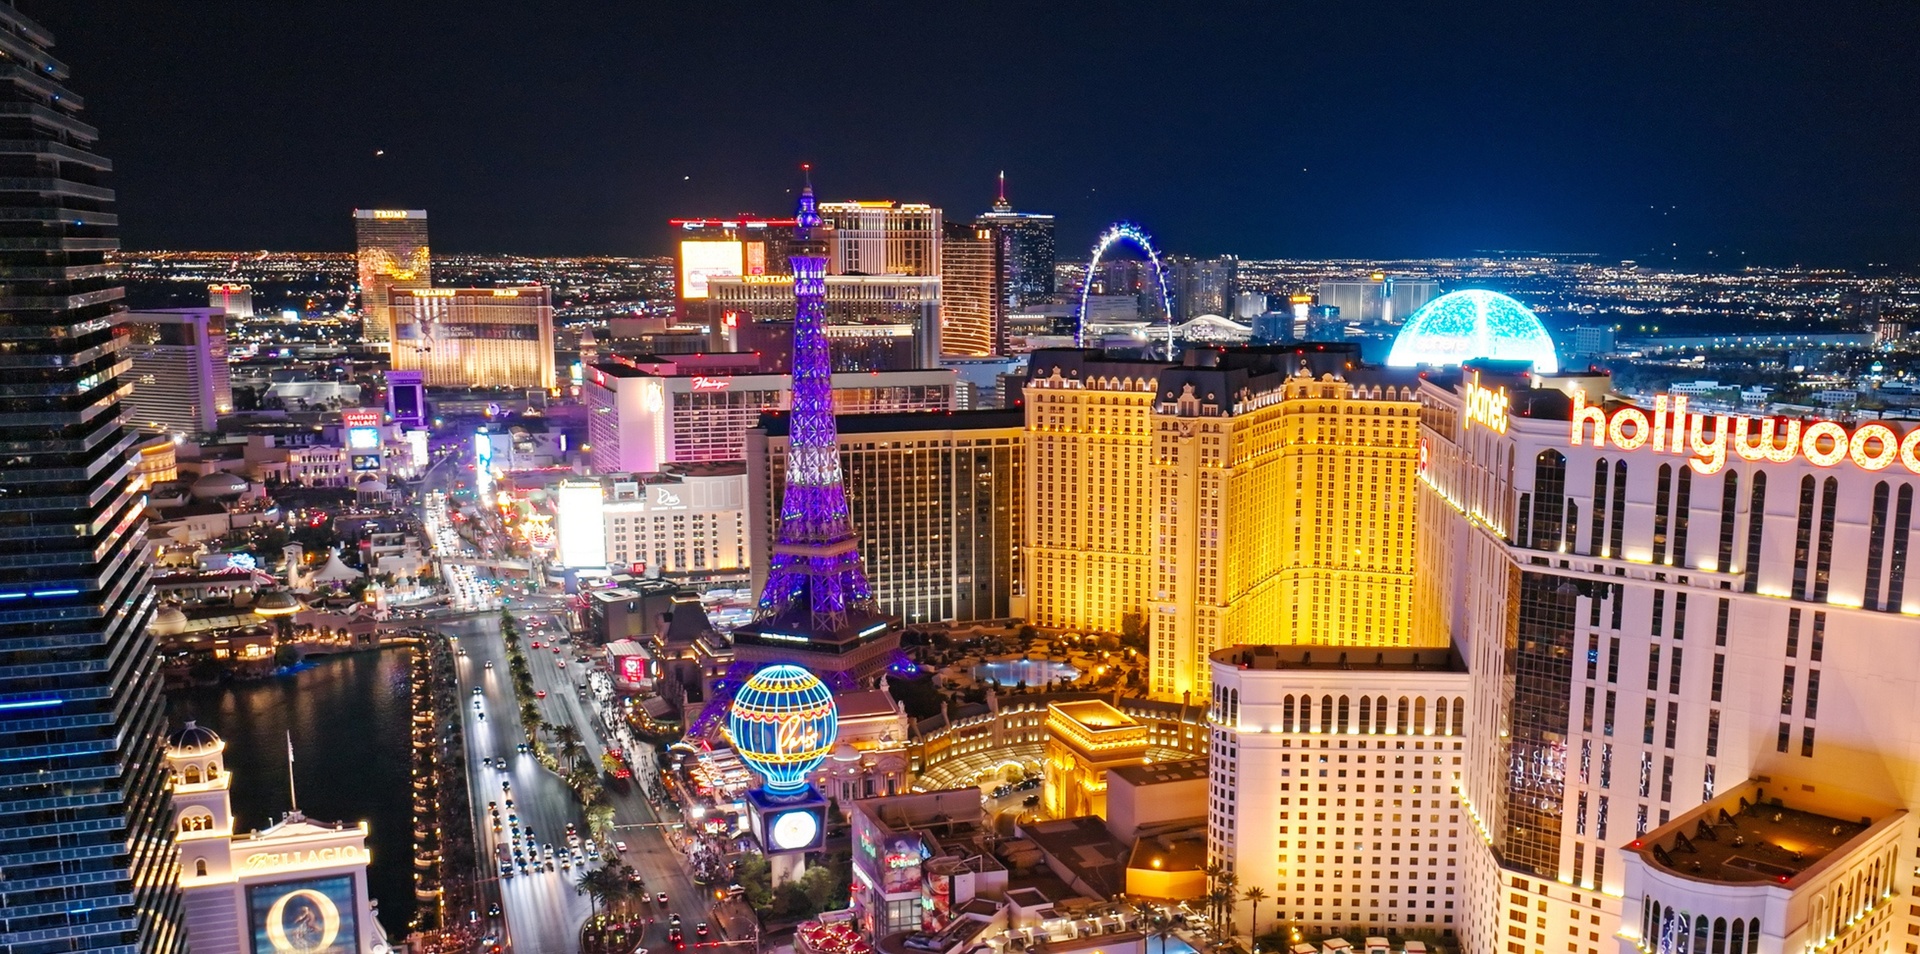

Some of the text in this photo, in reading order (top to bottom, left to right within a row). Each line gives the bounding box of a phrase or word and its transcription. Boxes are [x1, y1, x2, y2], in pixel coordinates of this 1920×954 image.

[374, 210, 408, 219] TRUMP
[744, 275, 795, 284] VENETIAN
[412, 289, 519, 297] TREASURE ISLAND
[692, 376, 730, 389] Flamingo
[1465, 370, 1508, 434] planet
[777, 714, 819, 763] Paris
[246, 845, 359, 869] BELLAGIO
[266, 889, 340, 954] O
